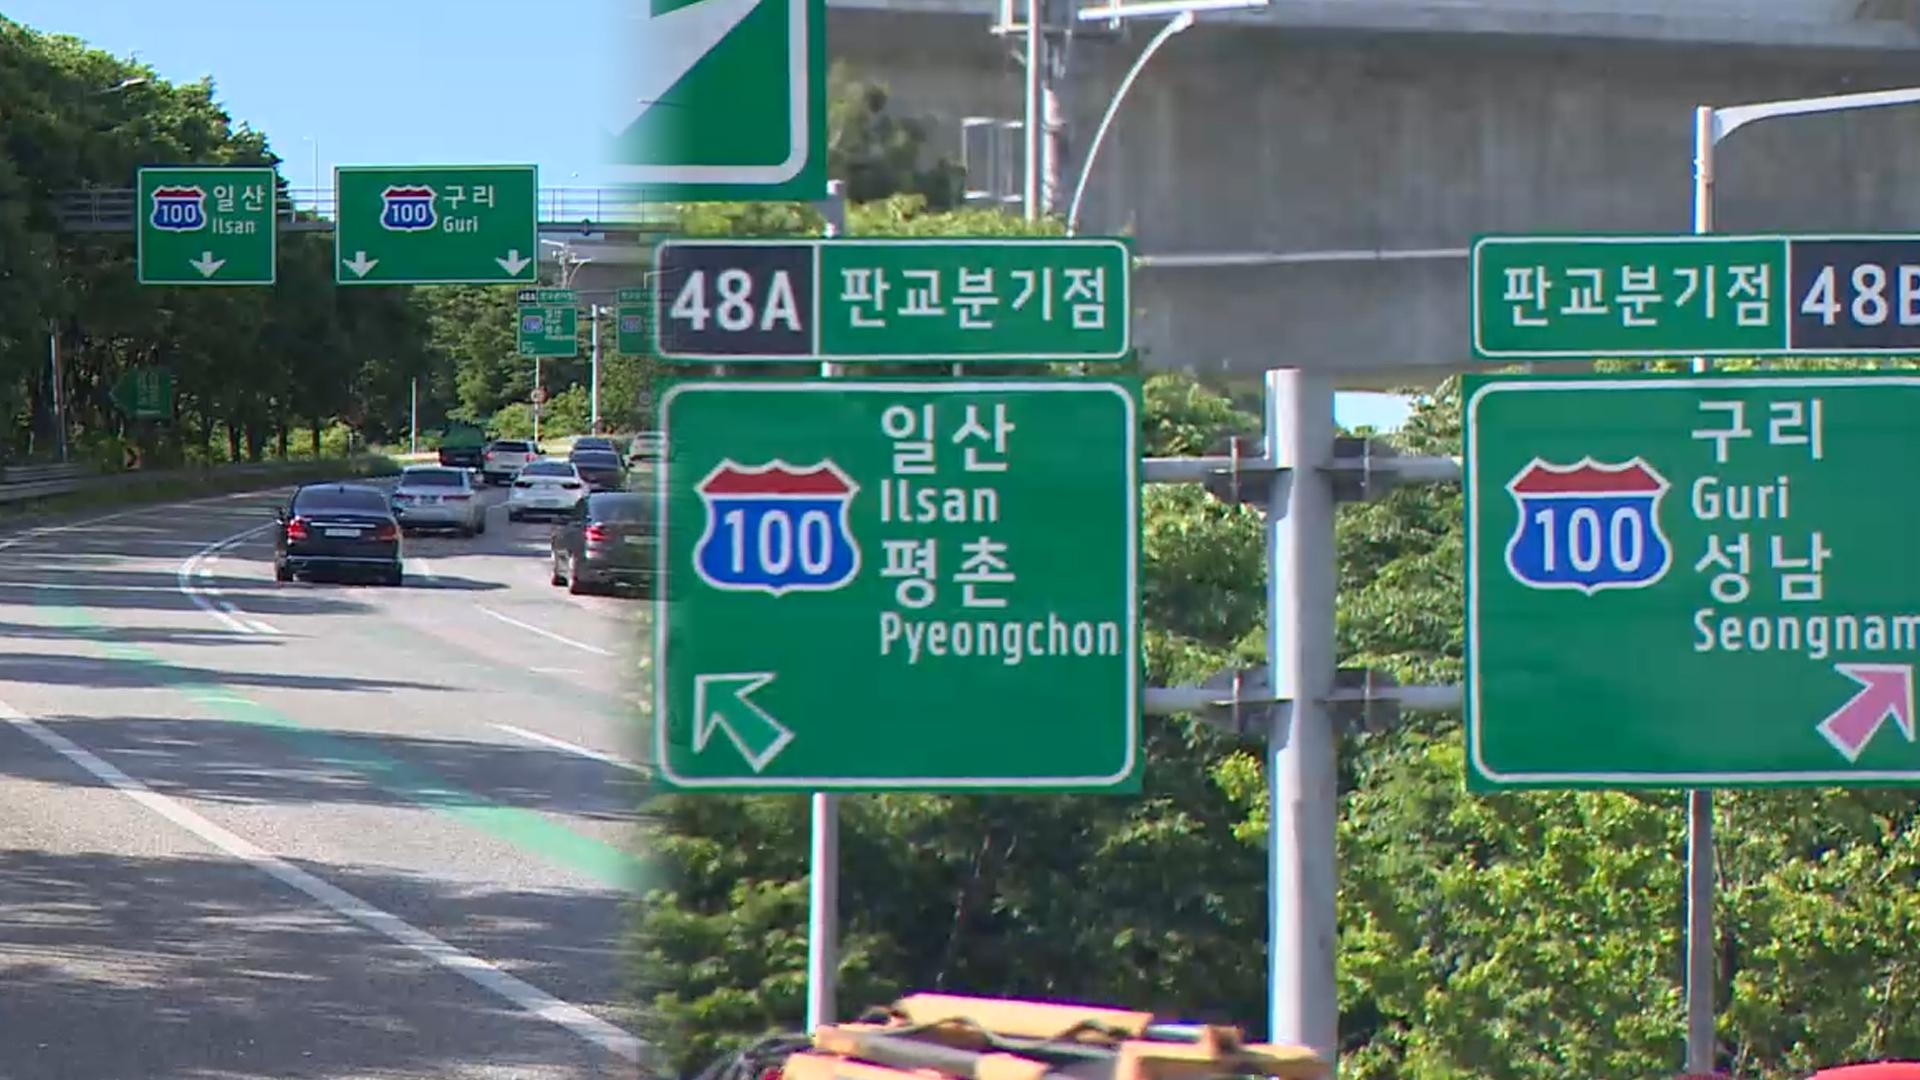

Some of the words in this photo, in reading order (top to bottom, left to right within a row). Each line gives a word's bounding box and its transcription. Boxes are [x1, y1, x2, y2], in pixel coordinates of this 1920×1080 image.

[160, 204, 196, 224] 100
[213, 183, 265, 213] 일산
[391, 203, 426, 223] 100
[443, 184, 495, 209] 구리
[212, 217, 256, 235] Ilsan
[443, 216, 479, 233] Guri
[670, 269, 802, 332] 48A
[840, 266, 1106, 330] 판교분기점
[1503, 264, 1771, 327] 판교분기점
[881, 403, 1016, 474] 일산
[1691, 399, 1824, 463] 구리
[880, 480, 999, 523] Ilsan
[1692, 475, 1790, 520] Guri
[724, 509, 831, 576] 100
[1535, 506, 1644, 573] 100
[879, 537, 1016, 609] 평촌
[1694, 532, 1832, 603] 성남
[880, 612, 1120, 664] Pyeongchon
[1693, 609, 1920, 660] Seongnam
